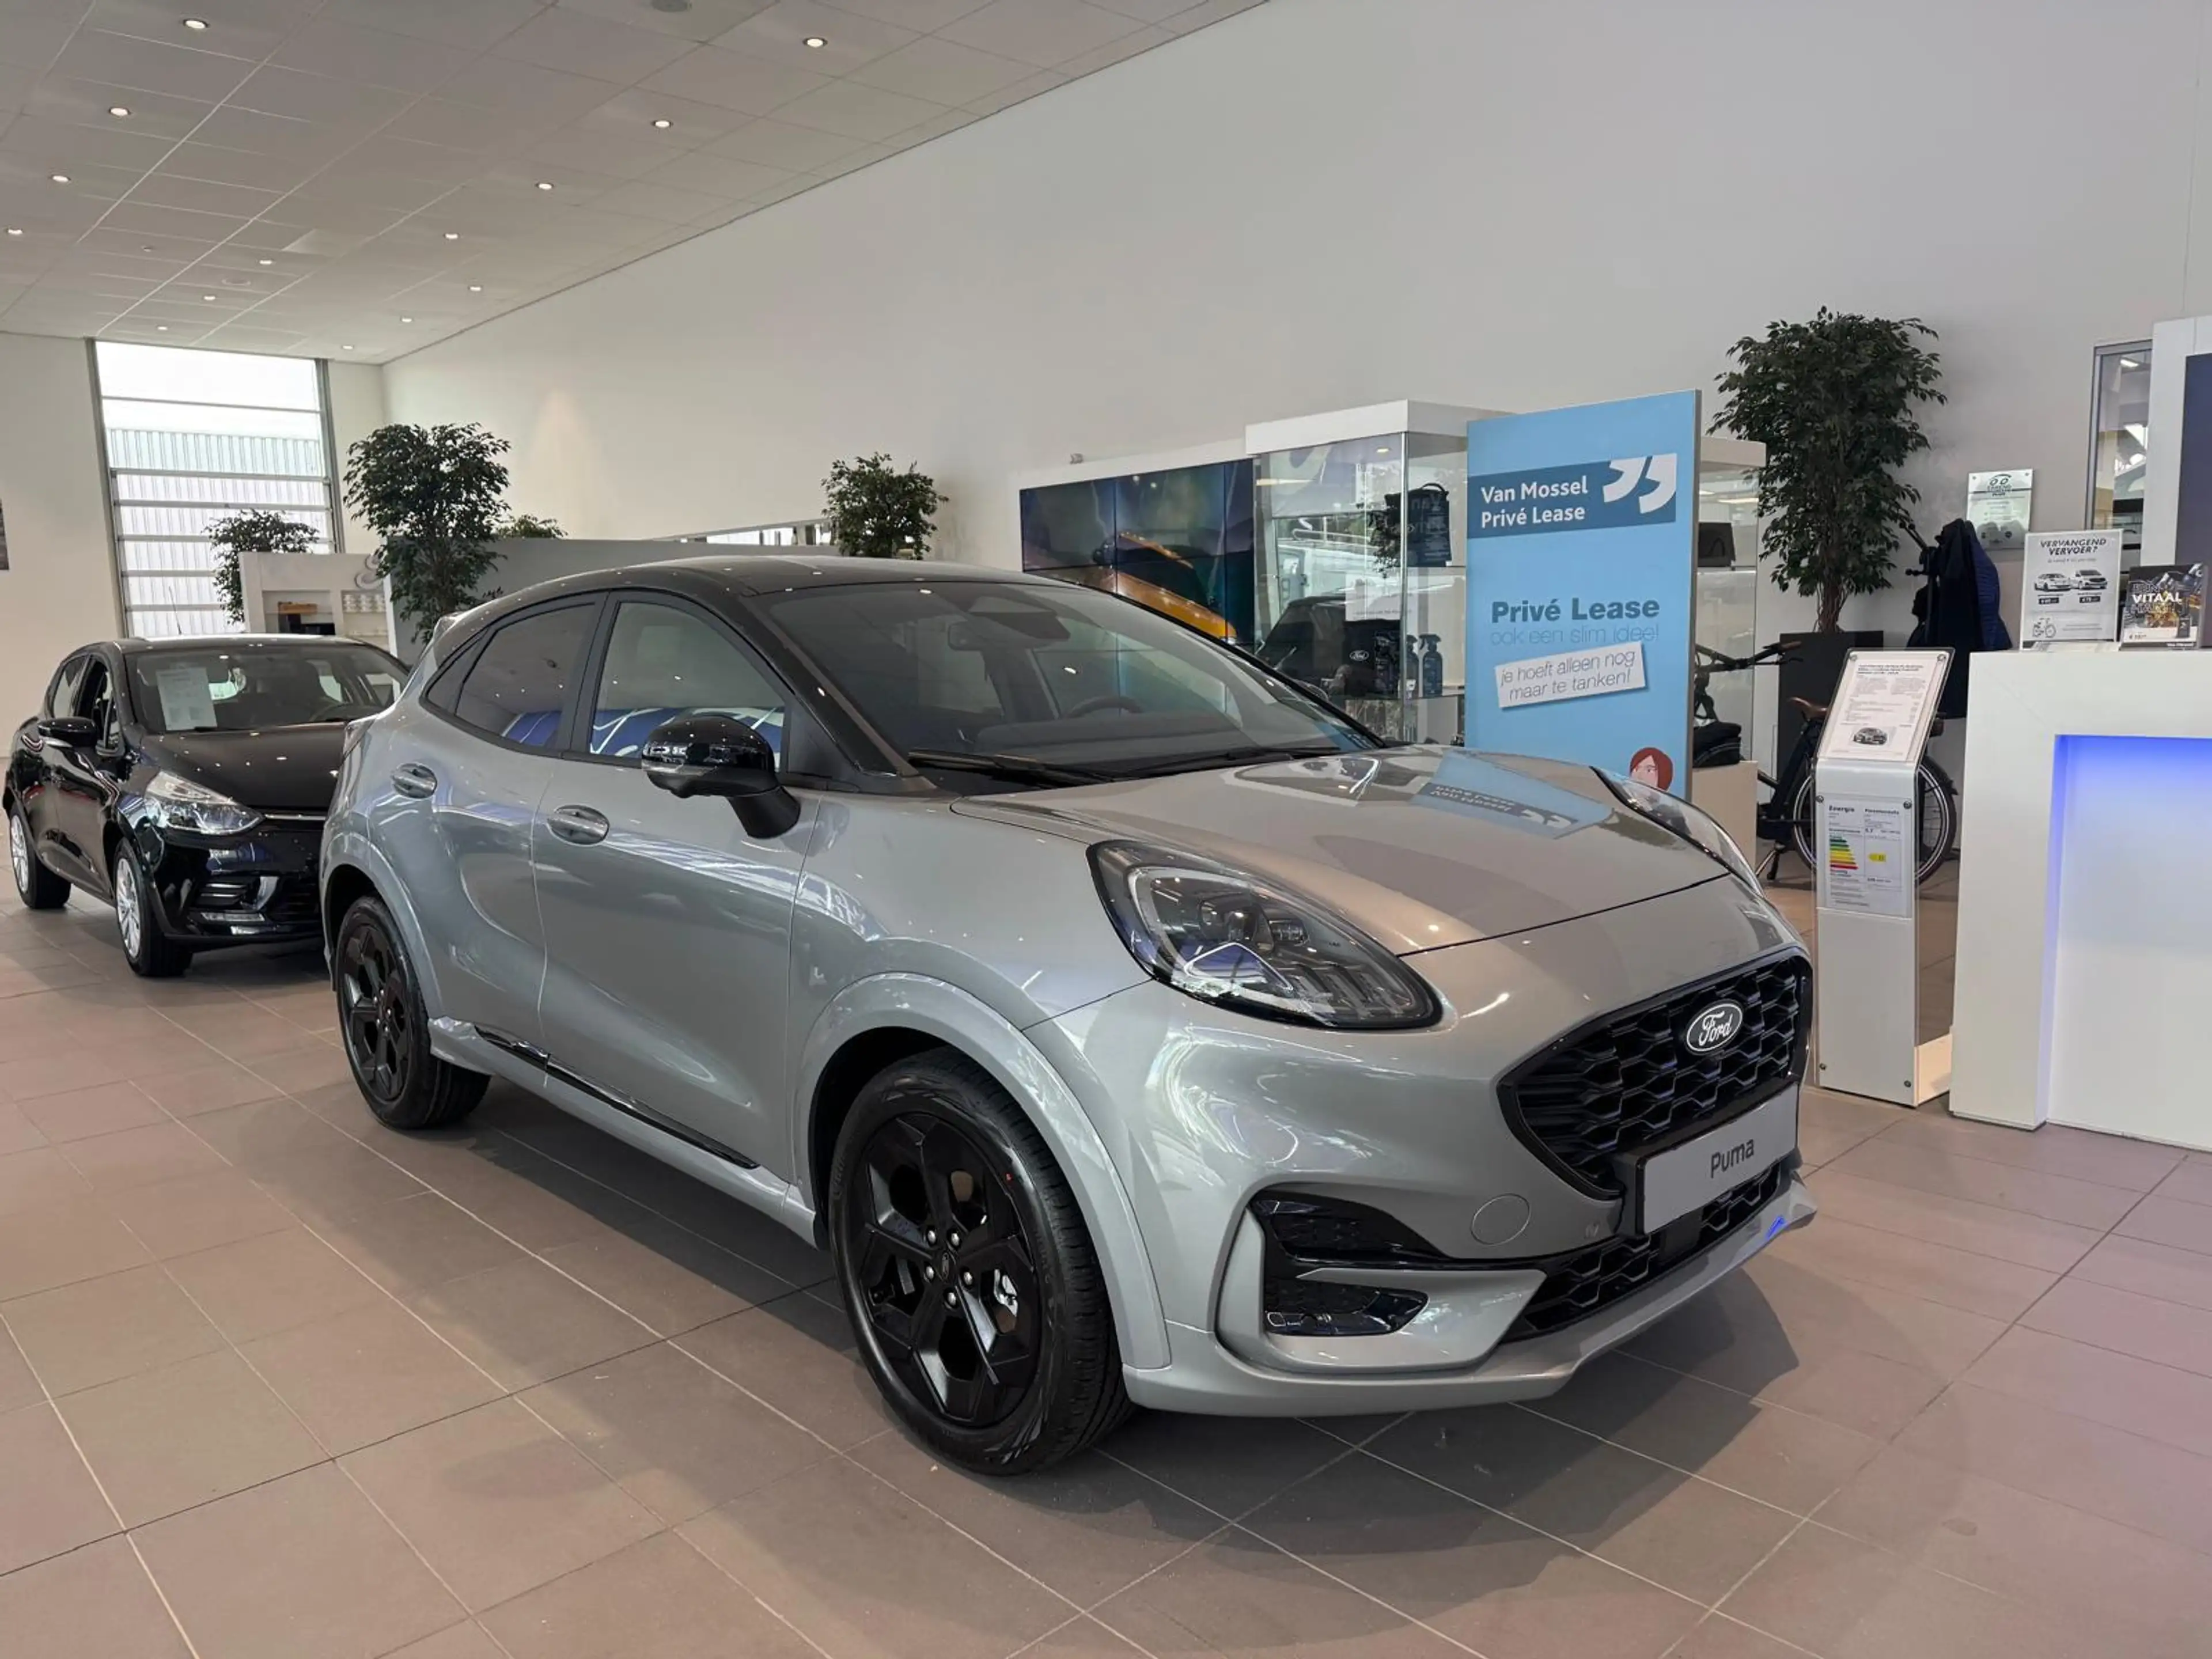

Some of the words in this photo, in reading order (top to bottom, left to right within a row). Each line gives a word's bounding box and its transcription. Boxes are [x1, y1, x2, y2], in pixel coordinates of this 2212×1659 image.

[1480, 486, 1515, 504] Van
[1521, 475, 1588, 500] Mossel
[1481, 507, 1527, 528] Privé
[1532, 506, 1585, 524] Lease
[2040, 538, 2107, 548] VERVANGEND
[2048, 546, 2099, 556] VERVOER?
[1491, 599, 1561, 623] Privé
[1571, 597, 1660, 620] Lease
[2132, 592, 2180, 604] VITAAL
[1491, 627, 1525, 645] ook
[1529, 628, 1563, 644] een
[1570, 625, 1607, 643] slim
[1613, 624, 1659, 642] idee!
[1501, 669, 1513, 686] je
[1517, 662, 1553, 681] hoeft
[1556, 656, 1600, 675] alleen
[1604, 651, 1635, 668] nog
[1509, 684, 1548, 701] maar
[1552, 680, 1567, 694] te
[1572, 668, 1631, 691] tanken!
[1698, 1009, 1733, 1047] Ford
[1710, 1138, 1755, 1179] Puma
